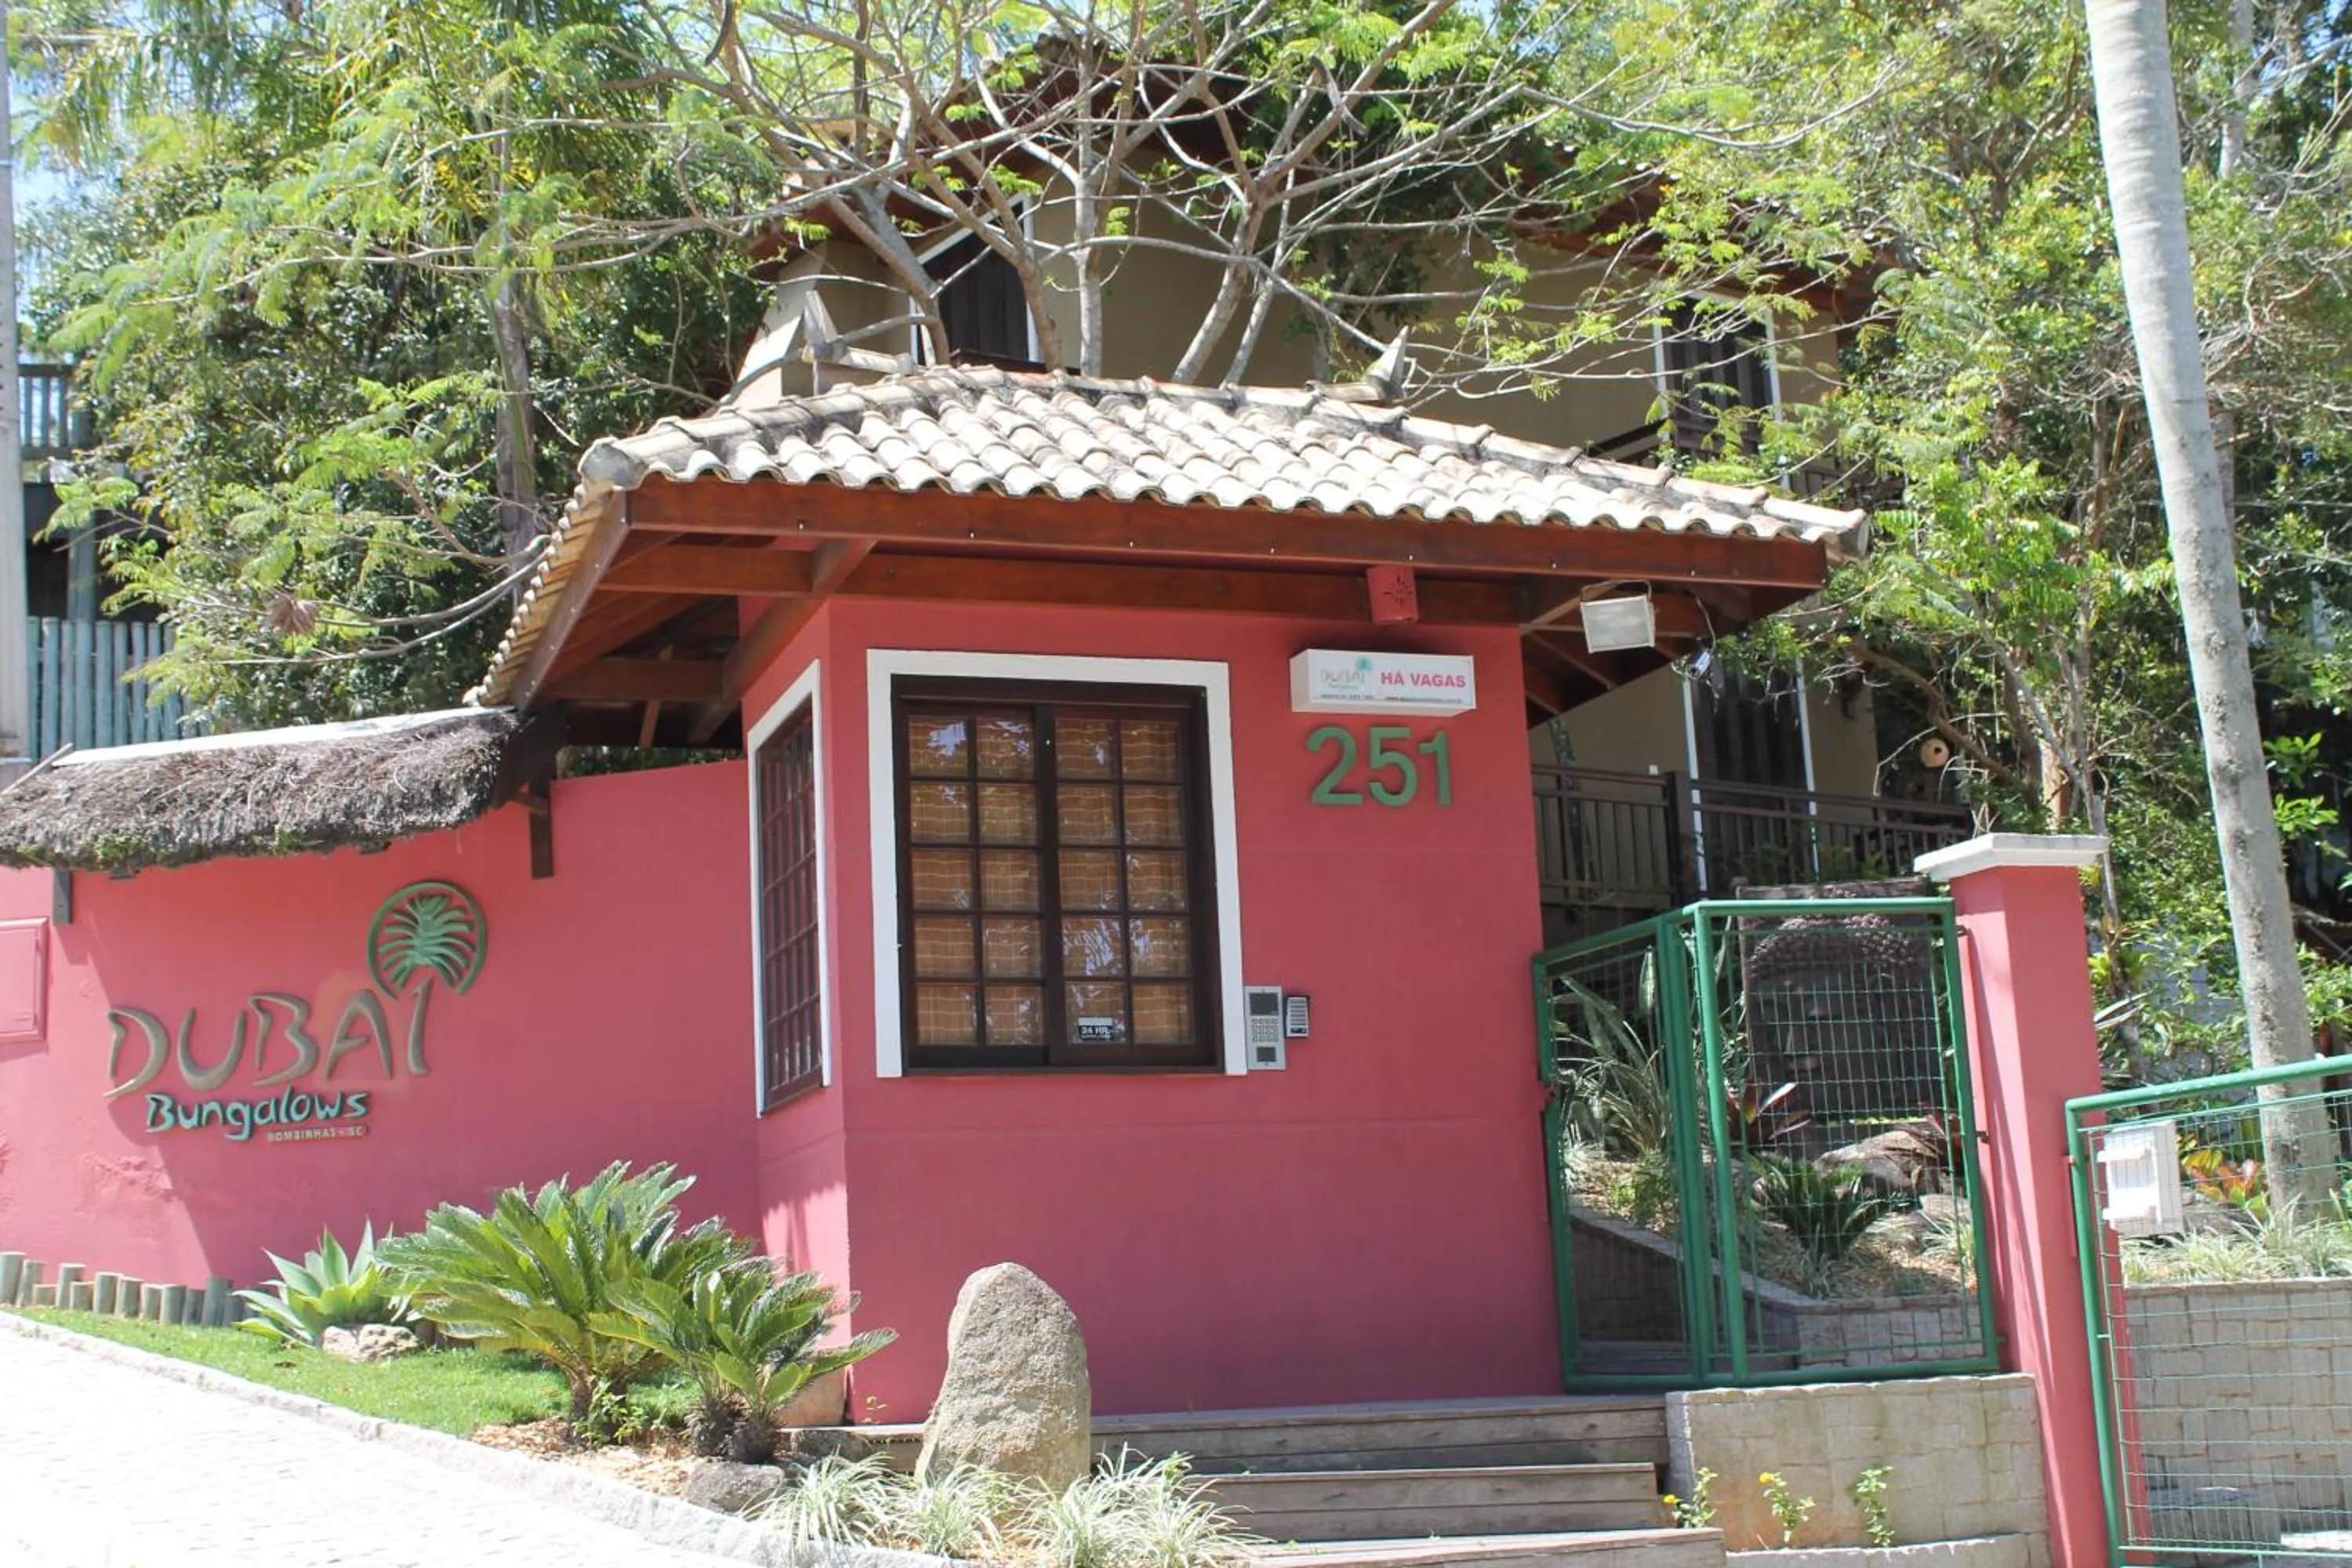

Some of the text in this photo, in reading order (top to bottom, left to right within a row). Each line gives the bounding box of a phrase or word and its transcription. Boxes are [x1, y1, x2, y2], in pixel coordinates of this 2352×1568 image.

[1410, 673, 1466, 688] VAGAS
[1305, 725, 1451, 807] 251
[101, 977, 434, 1098] DUBAI
[145, 1084, 370, 1142] Bungalows
[267, 1127, 336, 1142] BOMBINHAS
